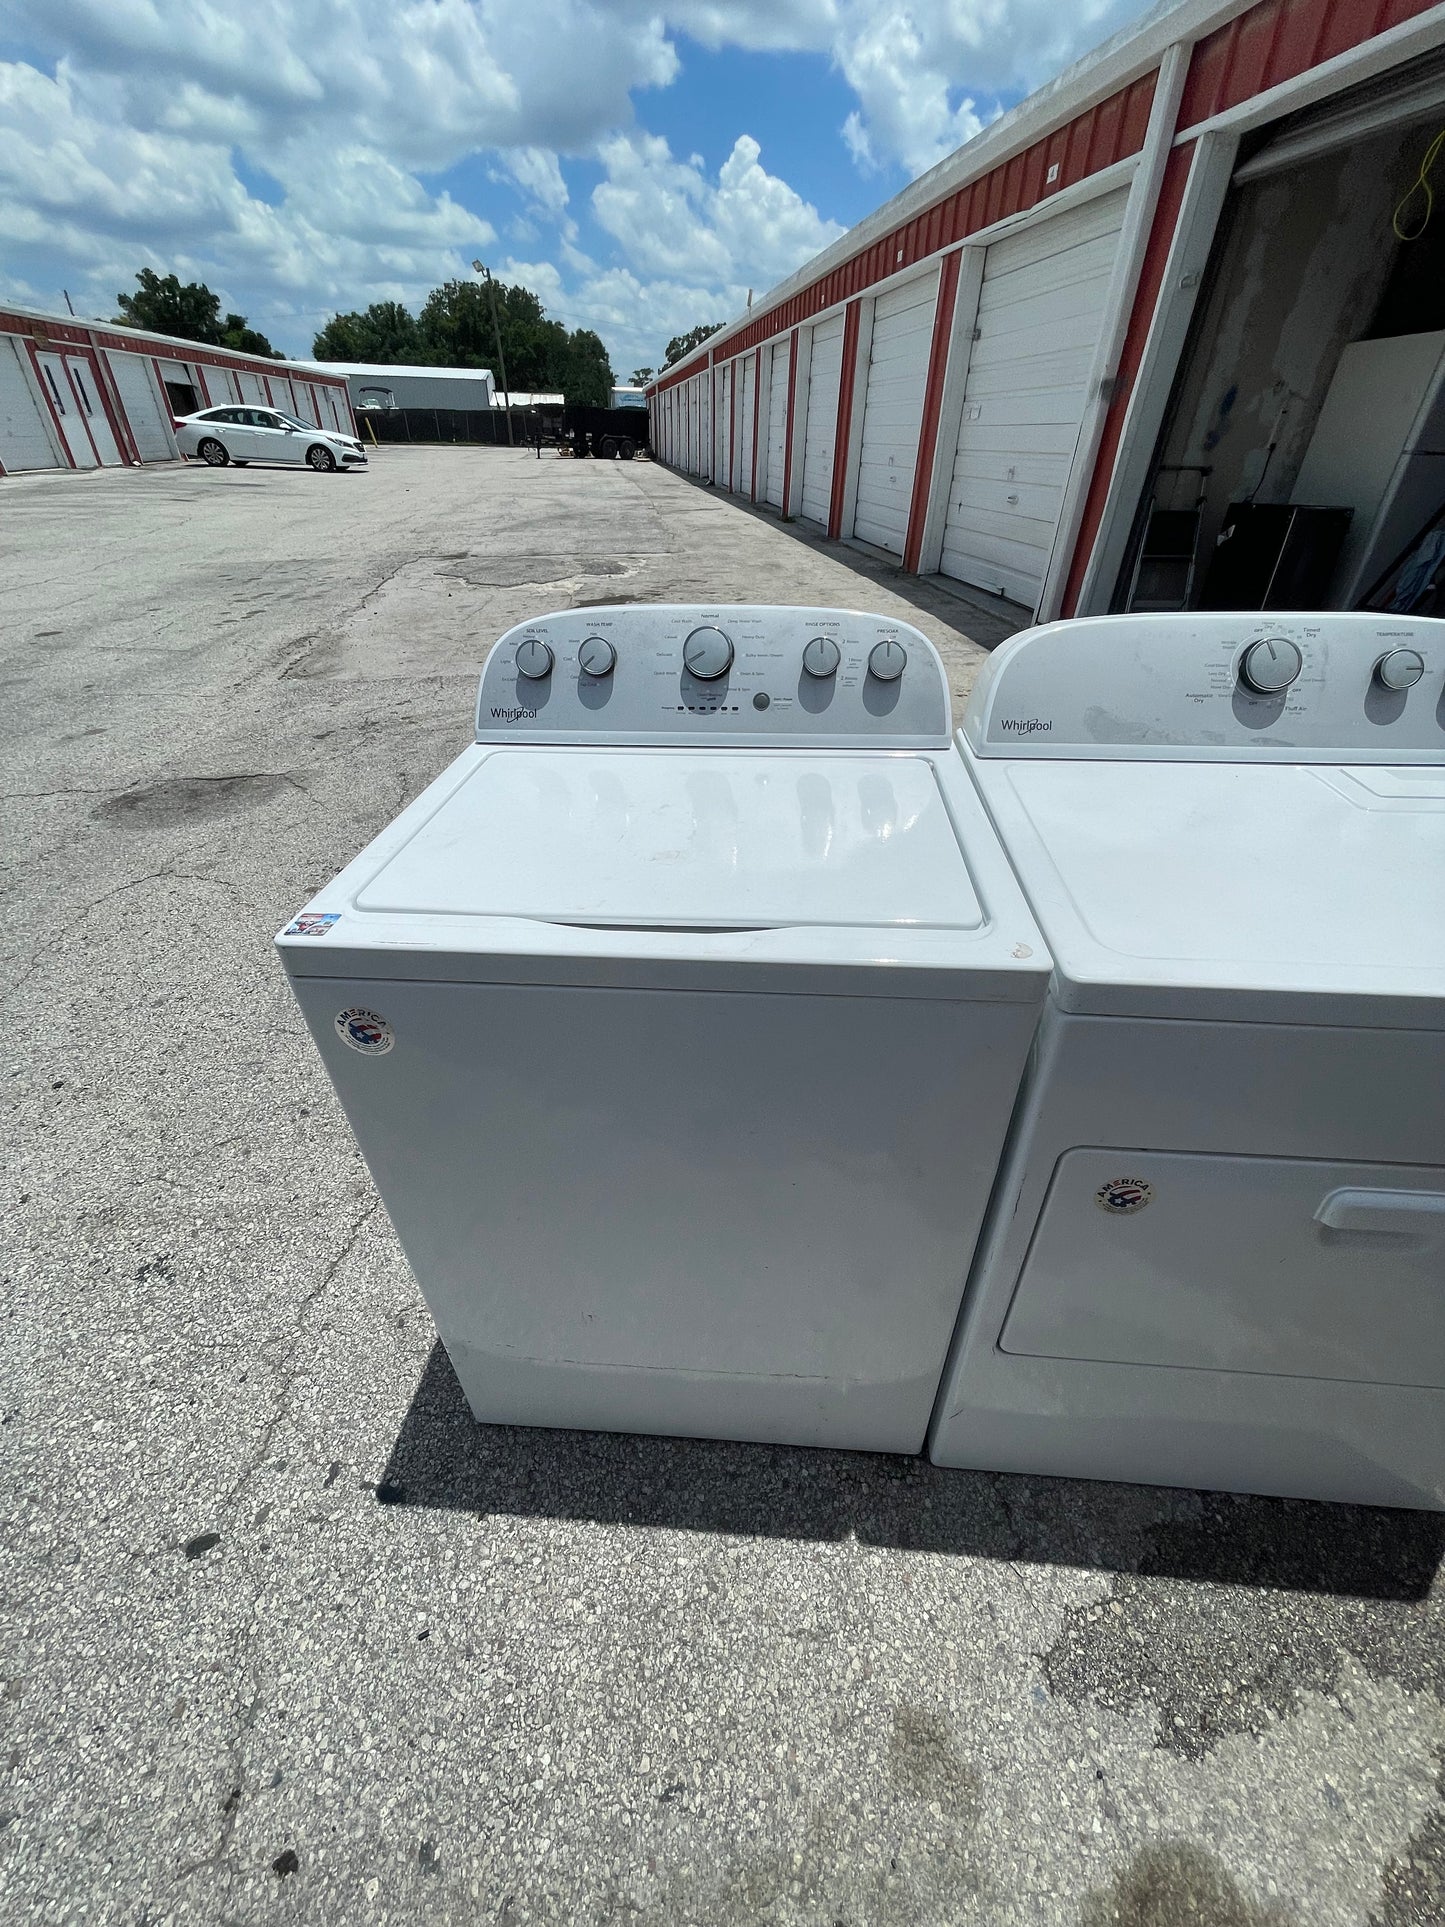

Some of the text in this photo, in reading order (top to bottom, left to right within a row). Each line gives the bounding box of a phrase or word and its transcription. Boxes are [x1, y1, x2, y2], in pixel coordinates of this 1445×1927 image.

[490, 707, 537, 723] Whirlpool
[1001, 719, 1052, 735] Whirlpool
[337, 1009, 386, 1028] AMERICA
[1097, 1178, 1149, 1198] AMERICA
